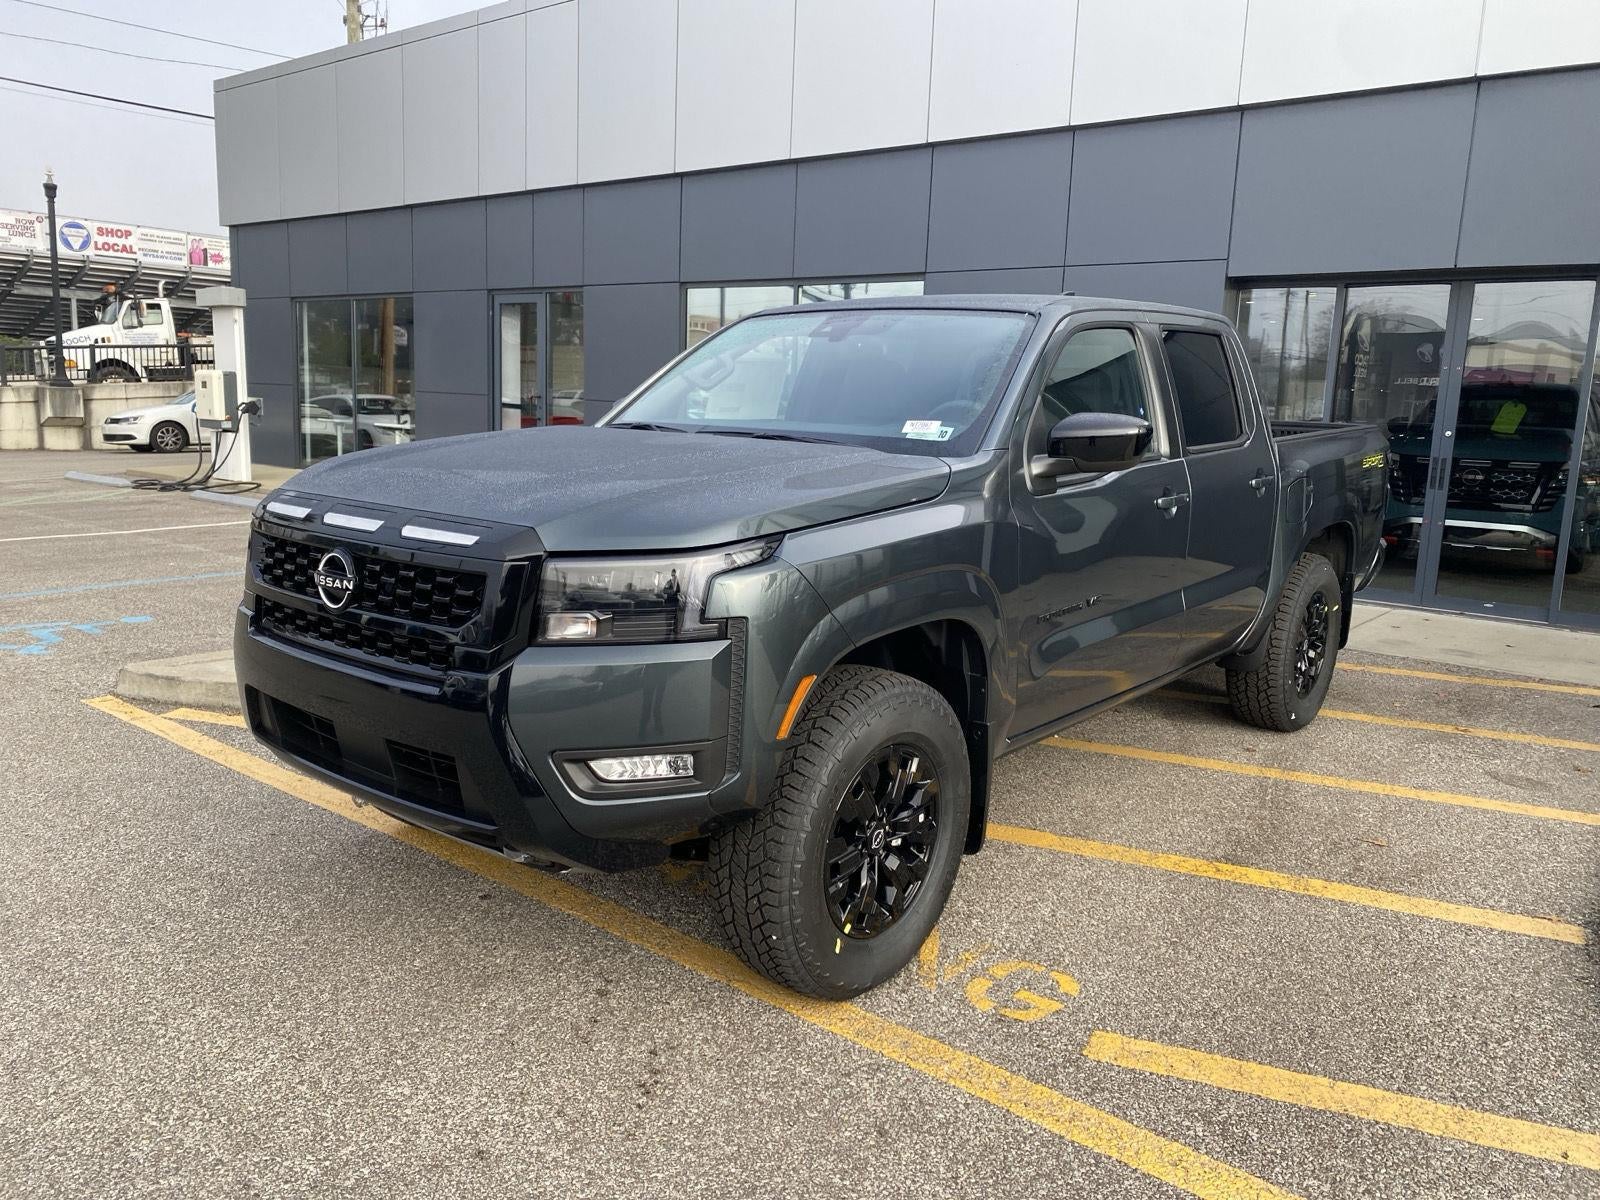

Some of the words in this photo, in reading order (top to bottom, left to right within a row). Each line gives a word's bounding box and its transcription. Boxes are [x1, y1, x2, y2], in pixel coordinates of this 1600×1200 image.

[15, 217, 35, 225] NOW
[0, 223, 36, 232] SERVING
[8, 230, 36, 239] LUNCH
[96, 226, 132, 239] SHOP
[94, 240, 138, 255] LOCAL
[938, 430, 948, 439] 10
[314, 573, 353, 590] NISSAN
